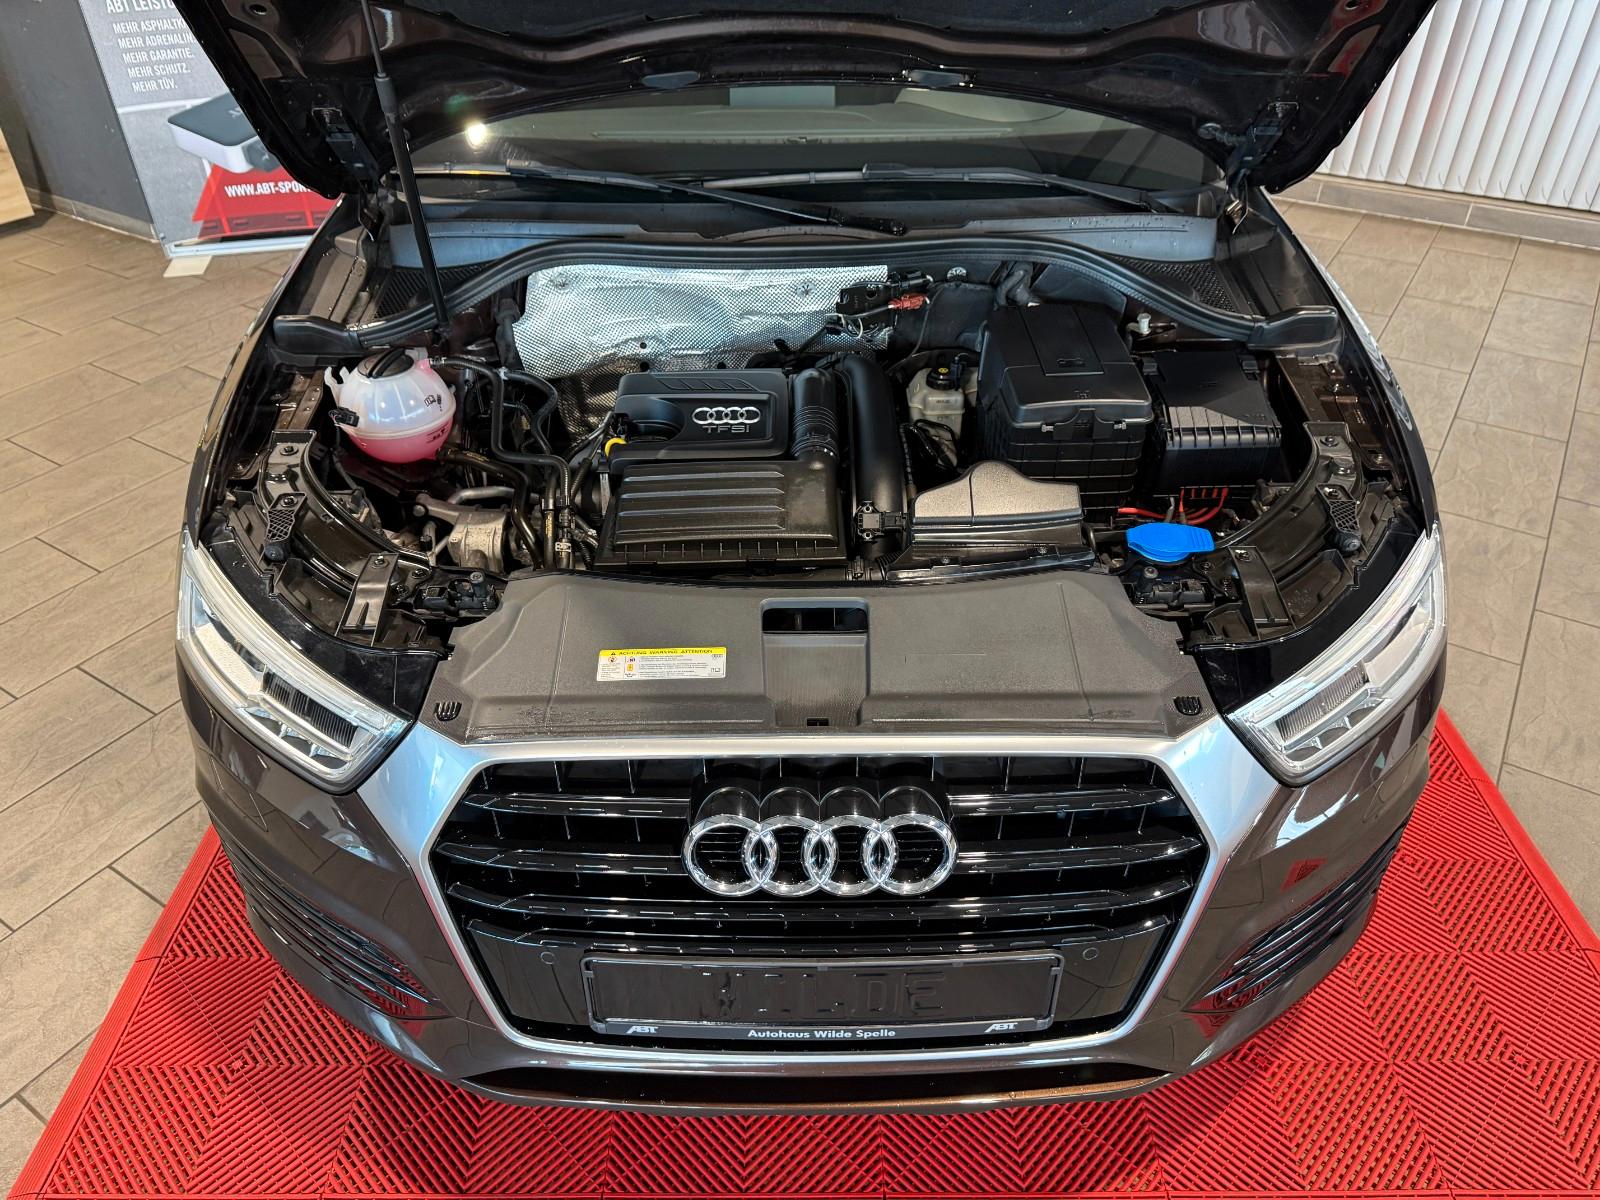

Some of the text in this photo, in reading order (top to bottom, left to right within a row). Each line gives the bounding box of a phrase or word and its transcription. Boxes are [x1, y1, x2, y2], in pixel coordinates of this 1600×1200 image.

[106, 0, 130, 13] ABT
[112, 21, 140, 34] MEHR
[117, 36, 145, 49] MEHR
[122, 47, 195, 64] MEHR GARANTIE.
[127, 62, 191, 79] MEHR SCHUTZ.
[132, 77, 178, 93] MEHR TÜV.
[224, 180, 311, 198] WWW.ABT-SPOR
[702, 424, 750, 433] TFSI
[626, 1022, 1019, 1040] ABT Autohaus Wilde Spelle ABT
